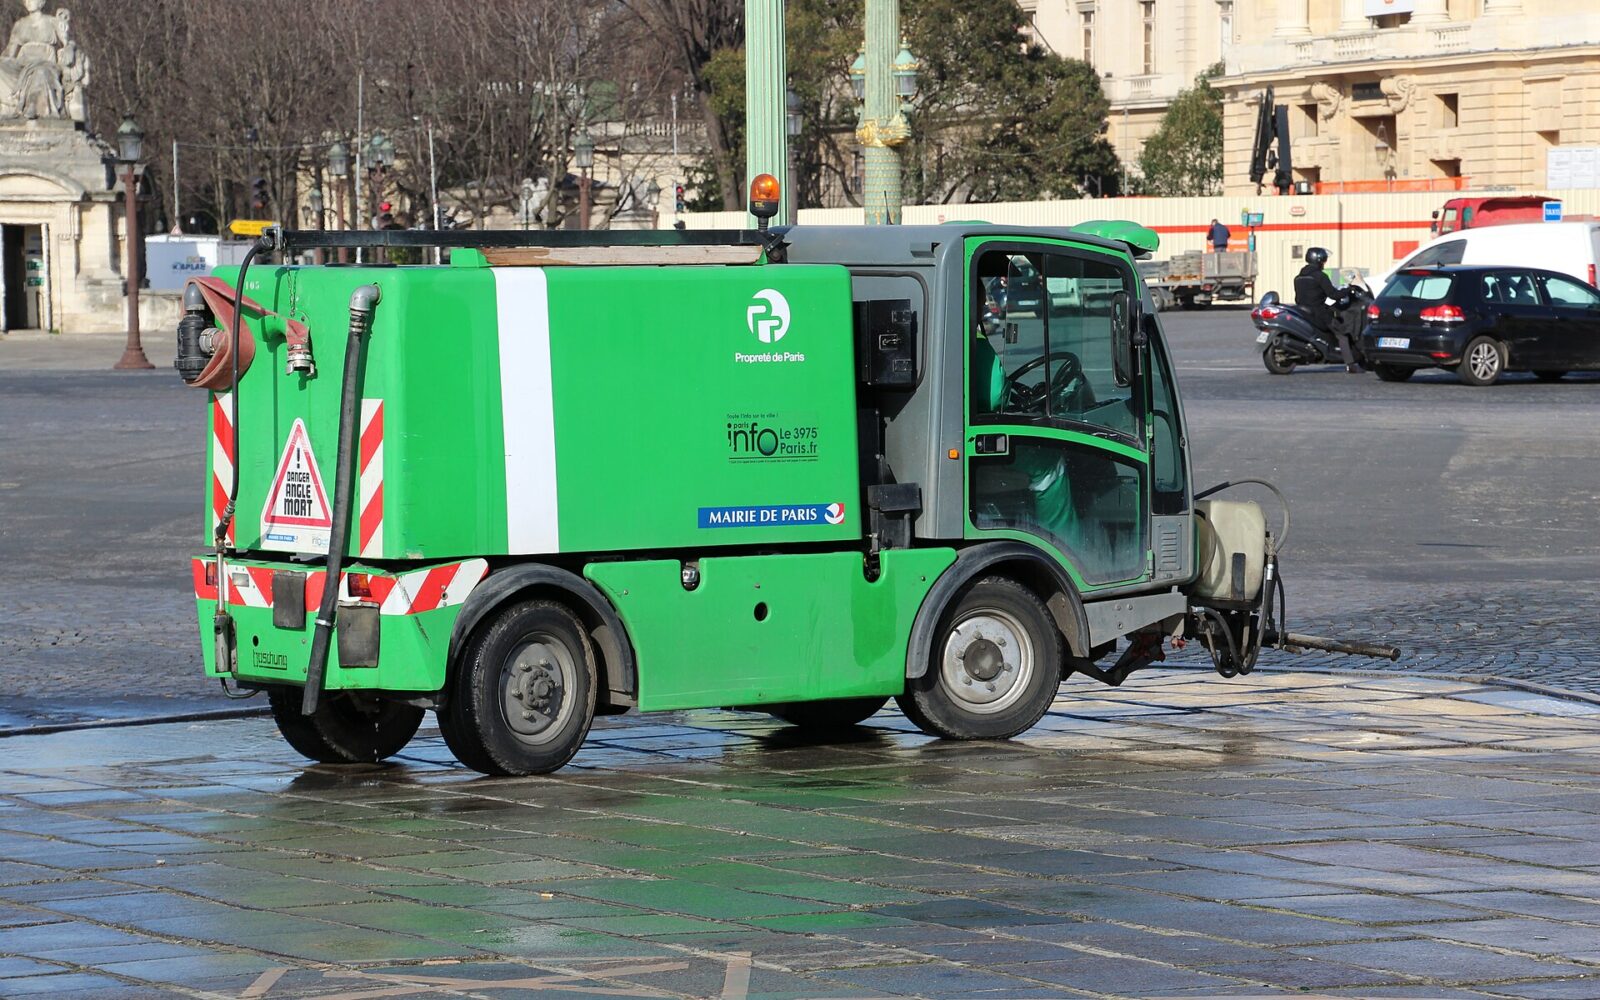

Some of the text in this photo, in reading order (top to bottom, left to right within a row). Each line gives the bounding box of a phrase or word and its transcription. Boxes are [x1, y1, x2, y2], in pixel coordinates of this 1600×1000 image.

[735, 352, 805, 363] Propreté de Paris
[727, 422, 779, 456] info
[780, 427, 818, 439] Le 3975
[780, 441, 818, 454] Paris.fr
[287, 471, 310, 482] DANGER
[286, 483, 311, 498] ANGLE
[284, 499, 313, 516] MORT
[709, 507, 818, 524] MAIRIE DE PARIS
